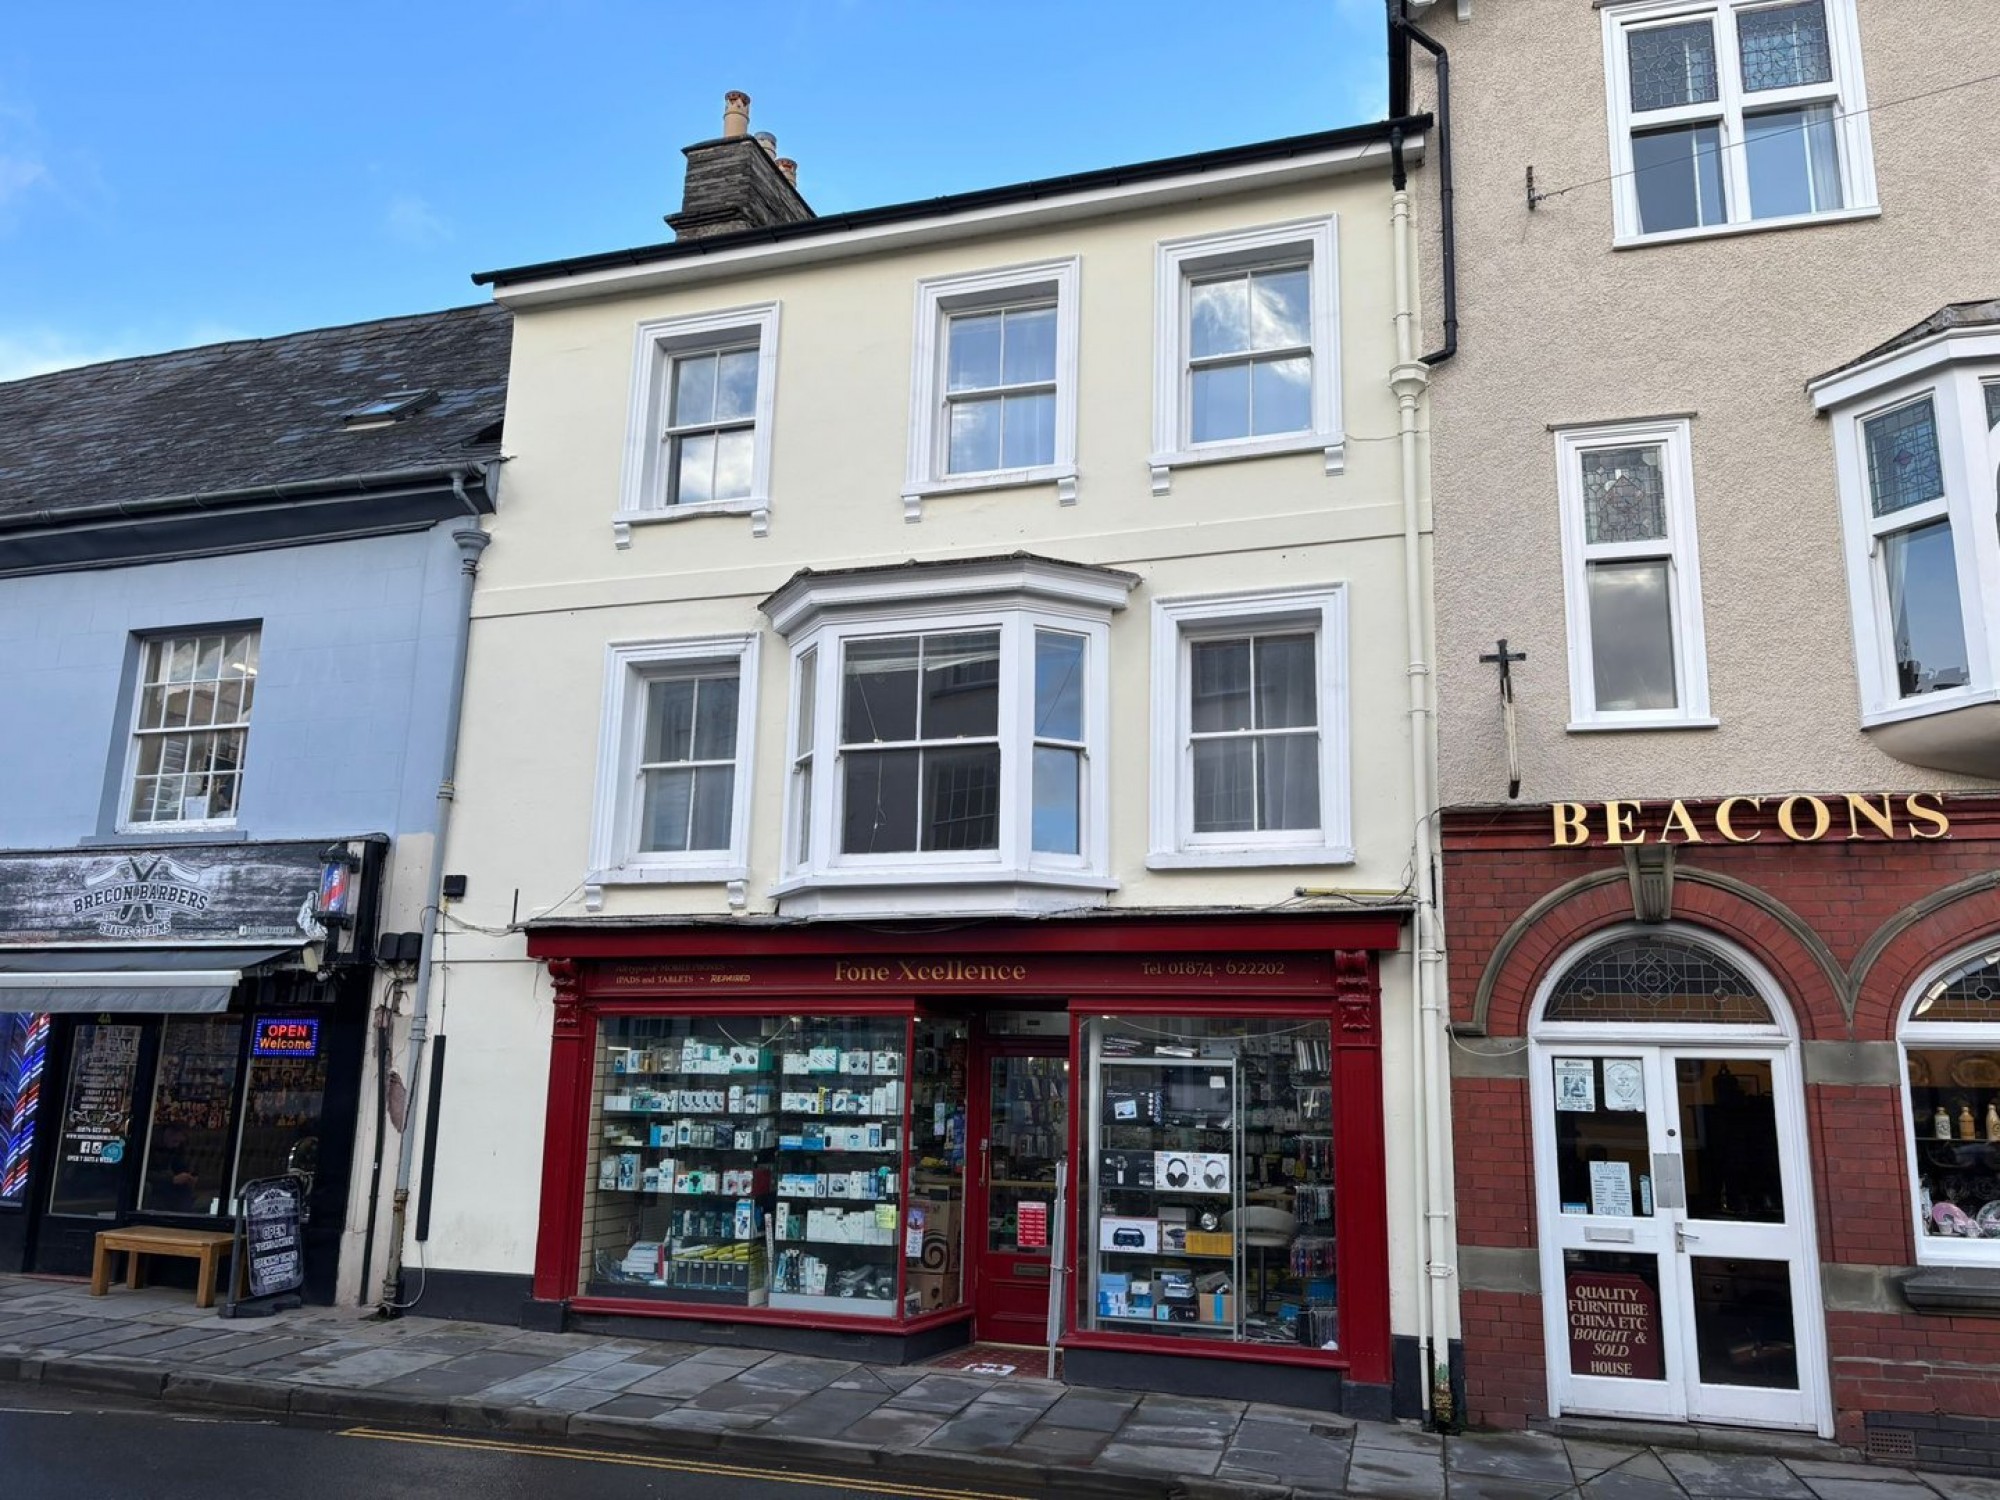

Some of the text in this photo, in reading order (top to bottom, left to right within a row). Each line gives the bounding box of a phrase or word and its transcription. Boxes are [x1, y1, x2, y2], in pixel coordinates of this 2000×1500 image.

[1551, 792, 1951, 846] BEACONS
[74, 884, 208, 913] BRECON BARBERS
[142, 920, 171, 936] TRIMS
[834, 960, 1027, 982] Fone Xcellence
[1168, 962, 1214, 977] 01874
[1225, 960, 1286, 976] 622202
[657, 974, 694, 984] TABLETS
[268, 1024, 308, 1037] OPEN
[260, 1037, 312, 1050] Welcome
[262, 1224, 287, 1240] OPEN
[1575, 1285, 1639, 1301] QUALITY
[1568, 1299, 1649, 1316] FURNITURE
[1570, 1313, 1616, 1328] CHINA
[1574, 1327, 1647, 1344] BOUGHT &
[1592, 1342, 1630, 1358] SOLD
[1591, 1360, 1633, 1376] HOUSE
